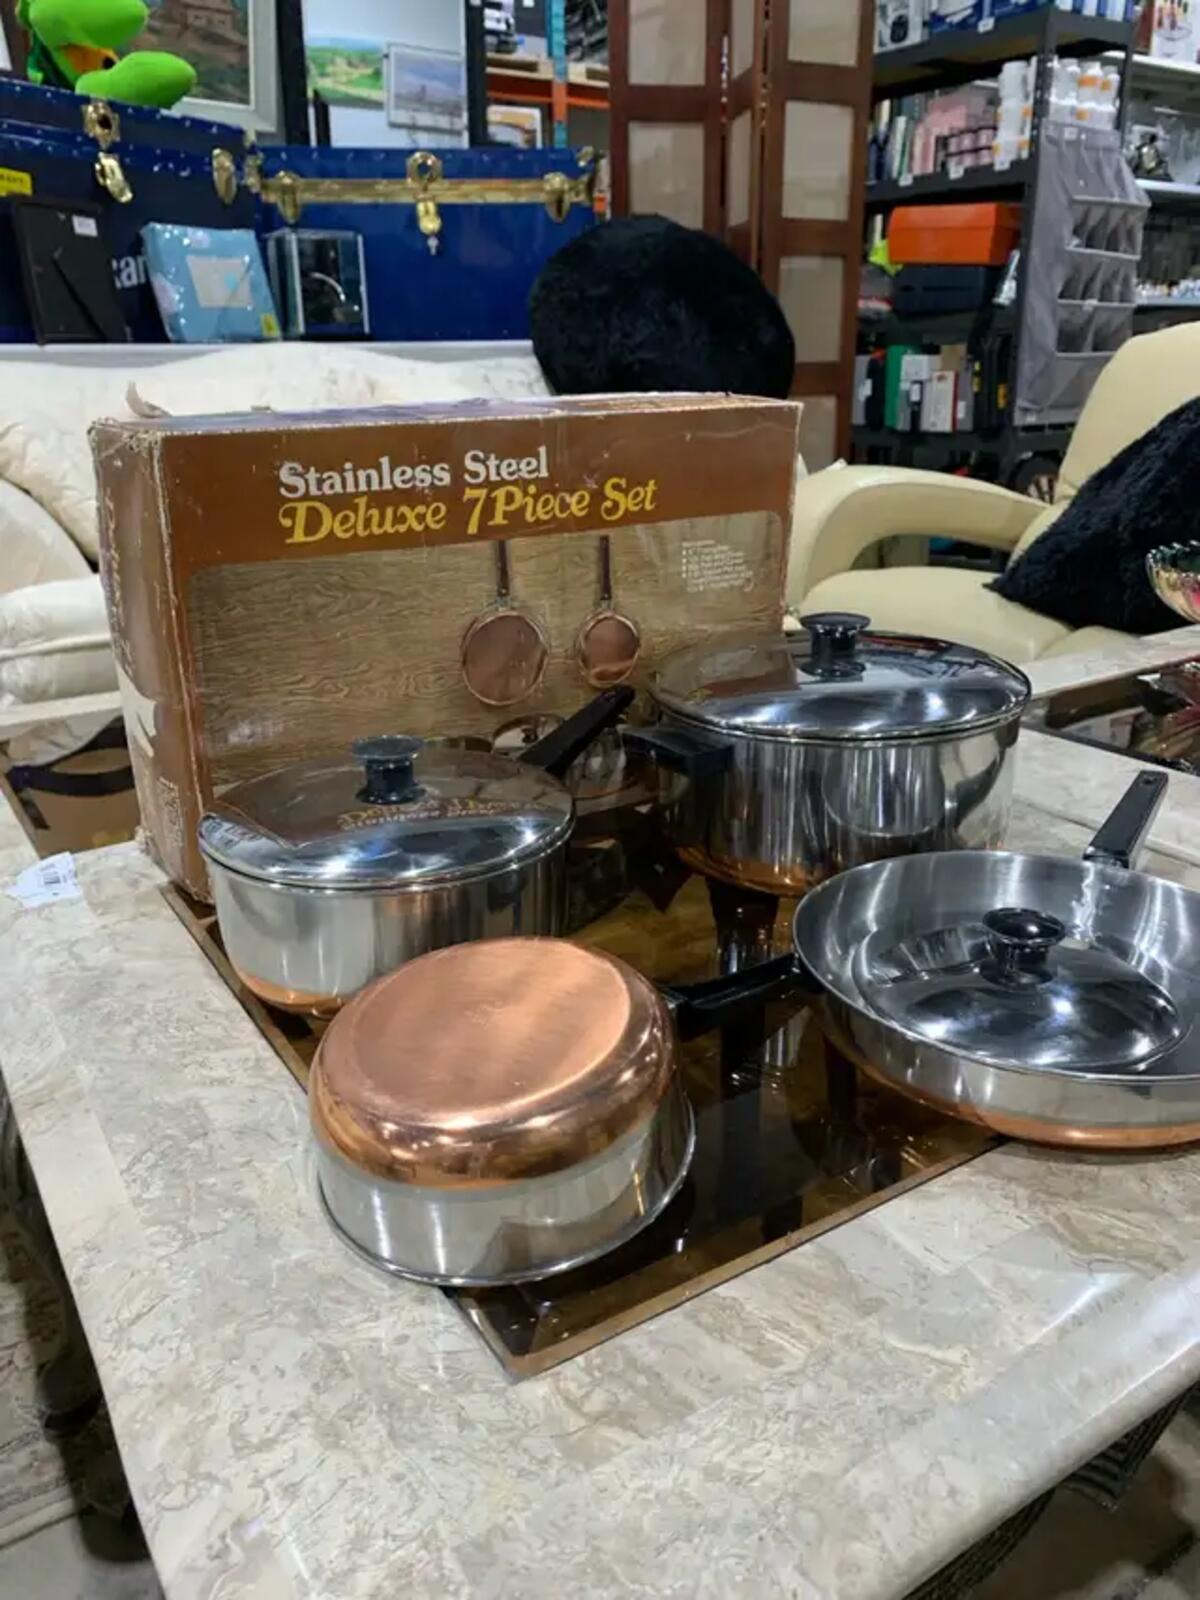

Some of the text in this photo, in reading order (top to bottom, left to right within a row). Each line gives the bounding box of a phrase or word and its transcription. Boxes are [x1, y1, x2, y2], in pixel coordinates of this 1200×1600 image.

[279, 444, 549, 498] Stainless Steel
[279, 495, 447, 545] Deluxe
[600, 476, 656, 521] Set
